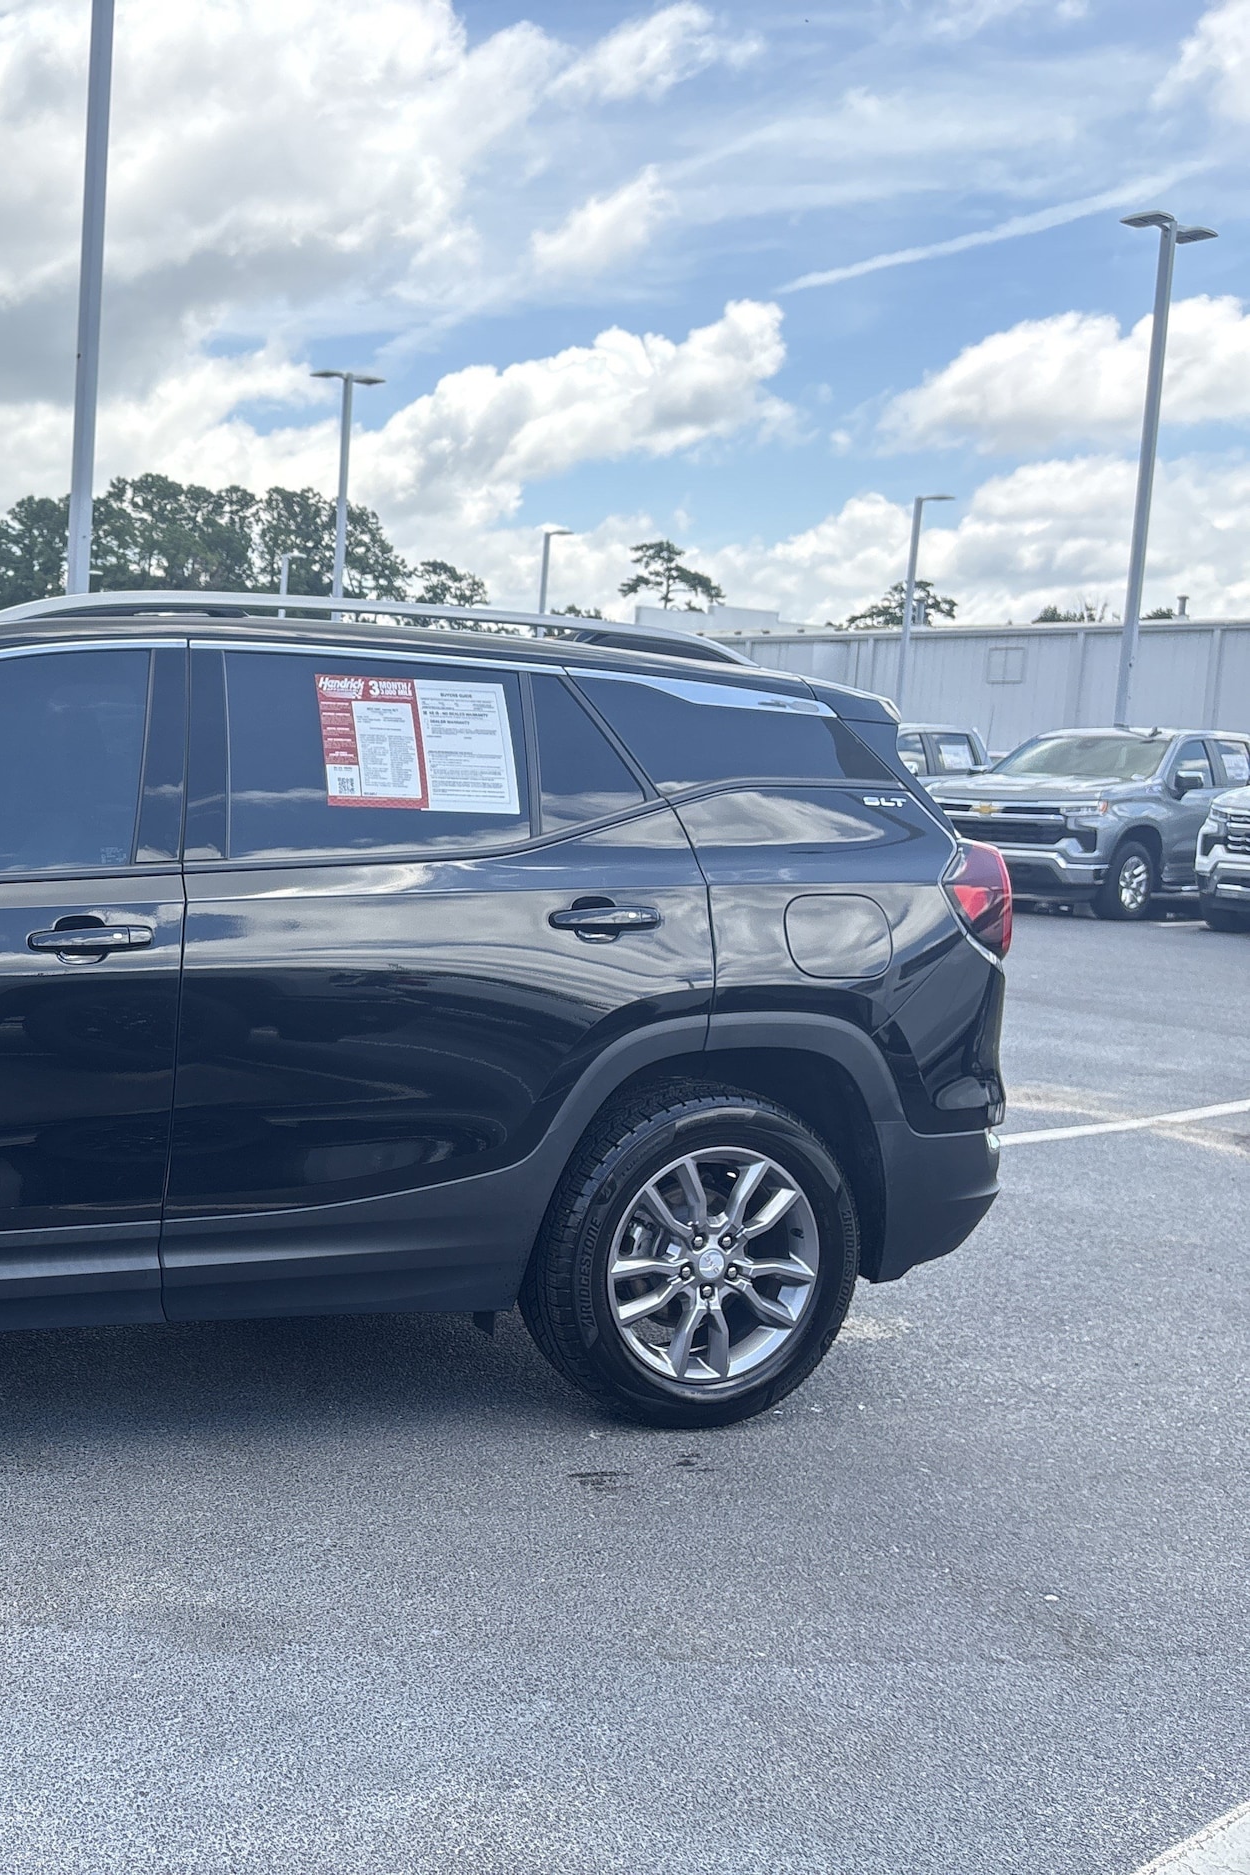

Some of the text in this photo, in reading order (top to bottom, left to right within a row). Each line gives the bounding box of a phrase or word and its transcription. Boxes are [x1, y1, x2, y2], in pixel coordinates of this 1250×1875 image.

[368, 680, 380, 696] 3
[863, 796, 907, 808] SLT
[579, 1218, 602, 1329] BRIDGESTONE
[834, 1209, 855, 1317] BRIDGESTONE
